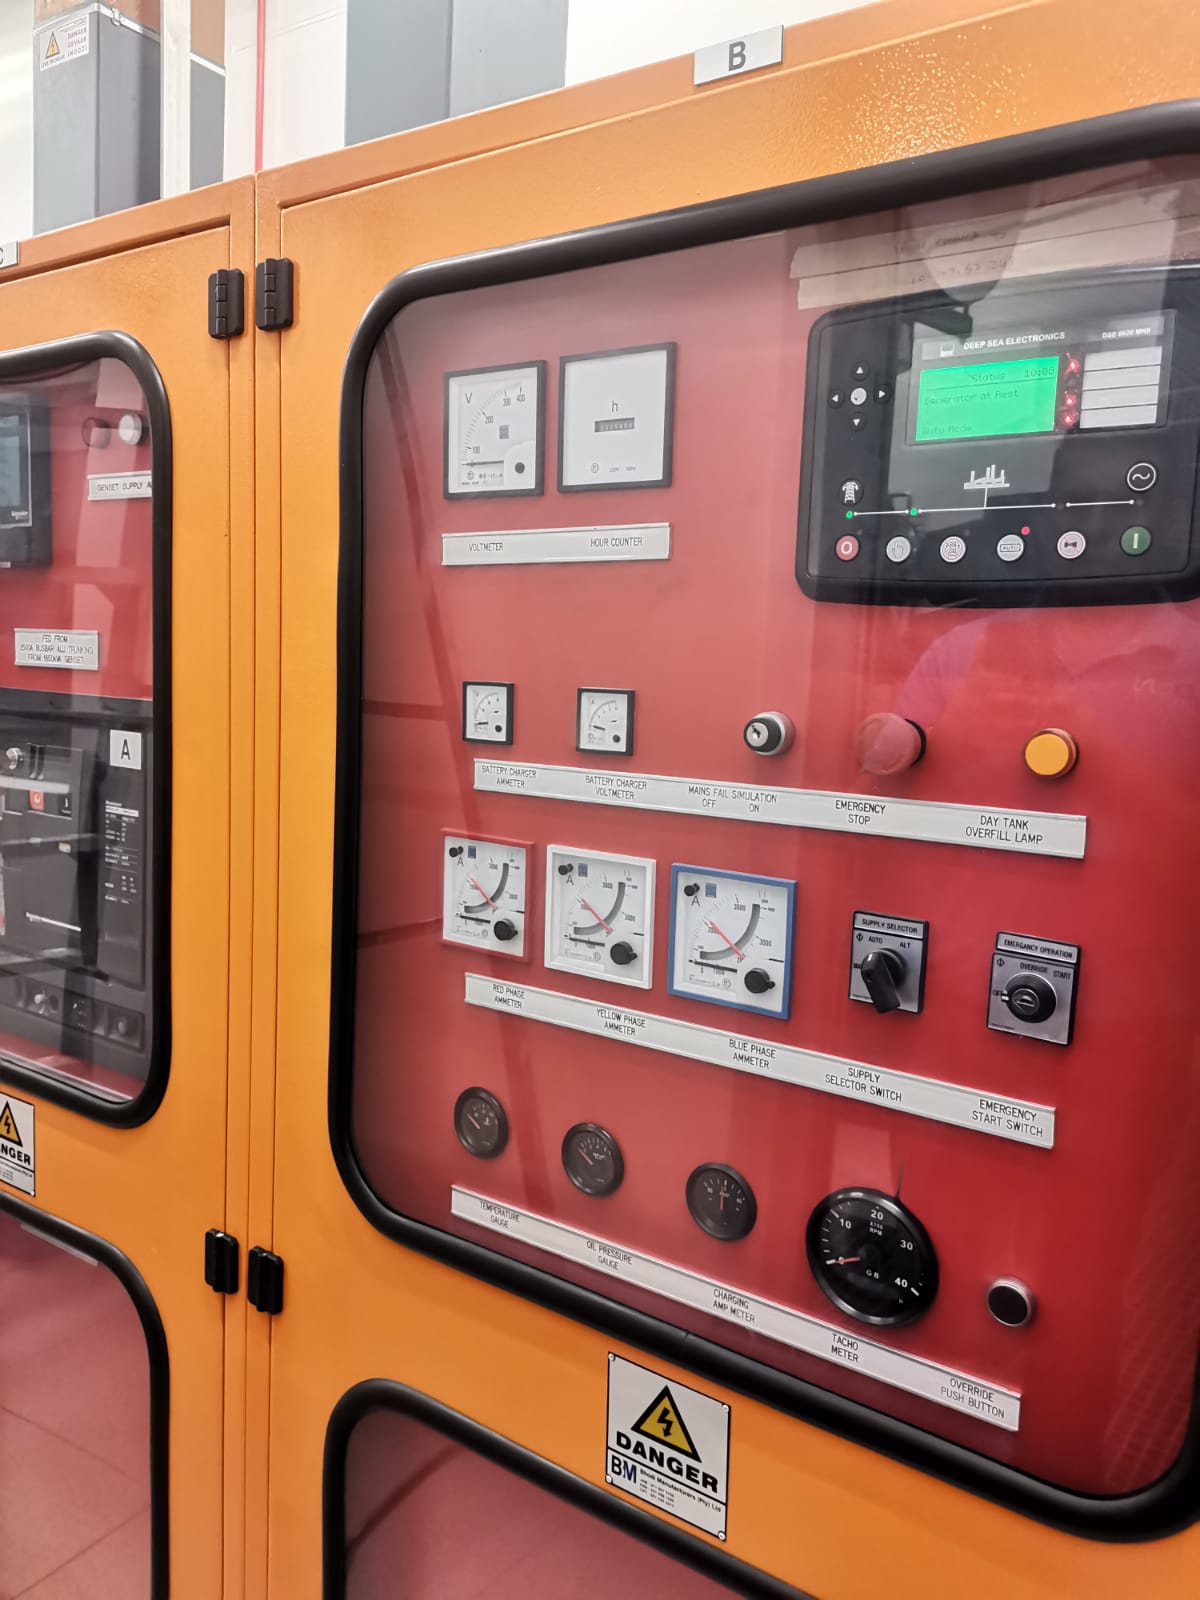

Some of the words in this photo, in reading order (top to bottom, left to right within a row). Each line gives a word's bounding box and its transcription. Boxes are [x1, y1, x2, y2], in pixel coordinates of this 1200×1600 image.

[728, 40, 746, 72] B
[963, 339, 986, 350] DEEP
[986, 338, 1005, 347] SEA
[1005, 331, 1066, 345] ELECTRONICS
[464, 391, 473, 405] V
[924, 394, 977, 406] Generator
[980, 392, 991, 401] at
[994, 389, 1020, 399] Rest
[611, 399, 619, 413] h
[469, 542, 504, 552] VOLTMETER
[590, 538, 609, 548] HOUR
[610, 536, 643, 547] COUNTER
[120, 738, 131, 760] A
[481, 764, 508, 775] BATTERY
[508, 767, 537, 779] CHARGER
[496, 777, 526, 788] AMMETER
[585, 775, 615, 786] BATTERY
[615, 778, 648, 790] CHARGER
[595, 787, 635, 800] VOLTMETER
[688, 785, 711, 796] MAINS
[713, 787, 730, 799] FAIL
[731, 790, 778, 803] SIMULATION
[702, 799, 717, 809] OFF
[749, 803, 760, 813] ON
[835, 800, 886, 815] EMERGENCY
[848, 814, 871, 825] STOP
[980, 815, 1000, 828] DAY
[1002, 817, 1029, 830] TANK
[965, 826, 1012, 842] OVERFILL
[1014, 833, 1044, 845] LAMP
[457, 856, 464, 867] A
[566, 874, 575, 886] A
[691, 895, 701, 907] A
[861, 918, 885, 928] SUPPLY
[886, 922, 918, 934] SELECTOR
[868, 935, 883, 944] AUTO
[899, 941, 911, 949] ALT
[1039, 946, 1073, 959] OPERATION
[1020, 962, 1048, 974] OVERRIDE
[1053, 970, 1071, 980] START
[492, 983, 505, 993] RED
[505, 987, 526, 1000] PHASE
[494, 995, 523, 1010] AMMETER
[596, 1008, 622, 1021] YELLOW
[623, 1015, 646, 1029] PHASE
[604, 1021, 636, 1036] AMMETER
[729, 1038, 749, 1052] BLUE
[750, 1044, 776, 1059] PHASE
[733, 1052, 770, 1070] AMMETER
[847, 1066, 881, 1084] SUPPLY
[825, 1073, 868, 1093] SELECTOR
[869, 1084, 903, 1104] SWITCH
[979, 1098, 1037, 1123] EMERGENCY
[971, 1110, 1003, 1127] START
[1006, 1119, 1043, 1138] SWITCH
[480, 1201, 521, 1223] TEMPERATURE
[870, 1209, 884, 1221] 20
[490, 1214, 509, 1229] GAUGE
[840, 1218, 852, 1230] 10
[869, 1227, 883, 1236] RPM
[586, 1240, 597, 1251] OIL
[598, 1245, 633, 1265] PRESSURE
[900, 1239, 913, 1251] 30
[597, 1255, 619, 1271] GAUGE
[894, 1277, 908, 1288] 40
[713, 1288, 750, 1310] CHARGING
[713, 1300, 729, 1312] AMP
[730, 1308, 756, 1324] METER
[832, 1333, 859, 1351] TACHO
[831, 1344, 859, 1363] METER
[949, 1377, 995, 1404] OVERRIDE
[940, 1386, 965, 1404] PUSH
[967, 1396, 1005, 1420] BUTTON
[611, 1454, 637, 1484] BM
[616, 1430, 719, 1494] DANGER
